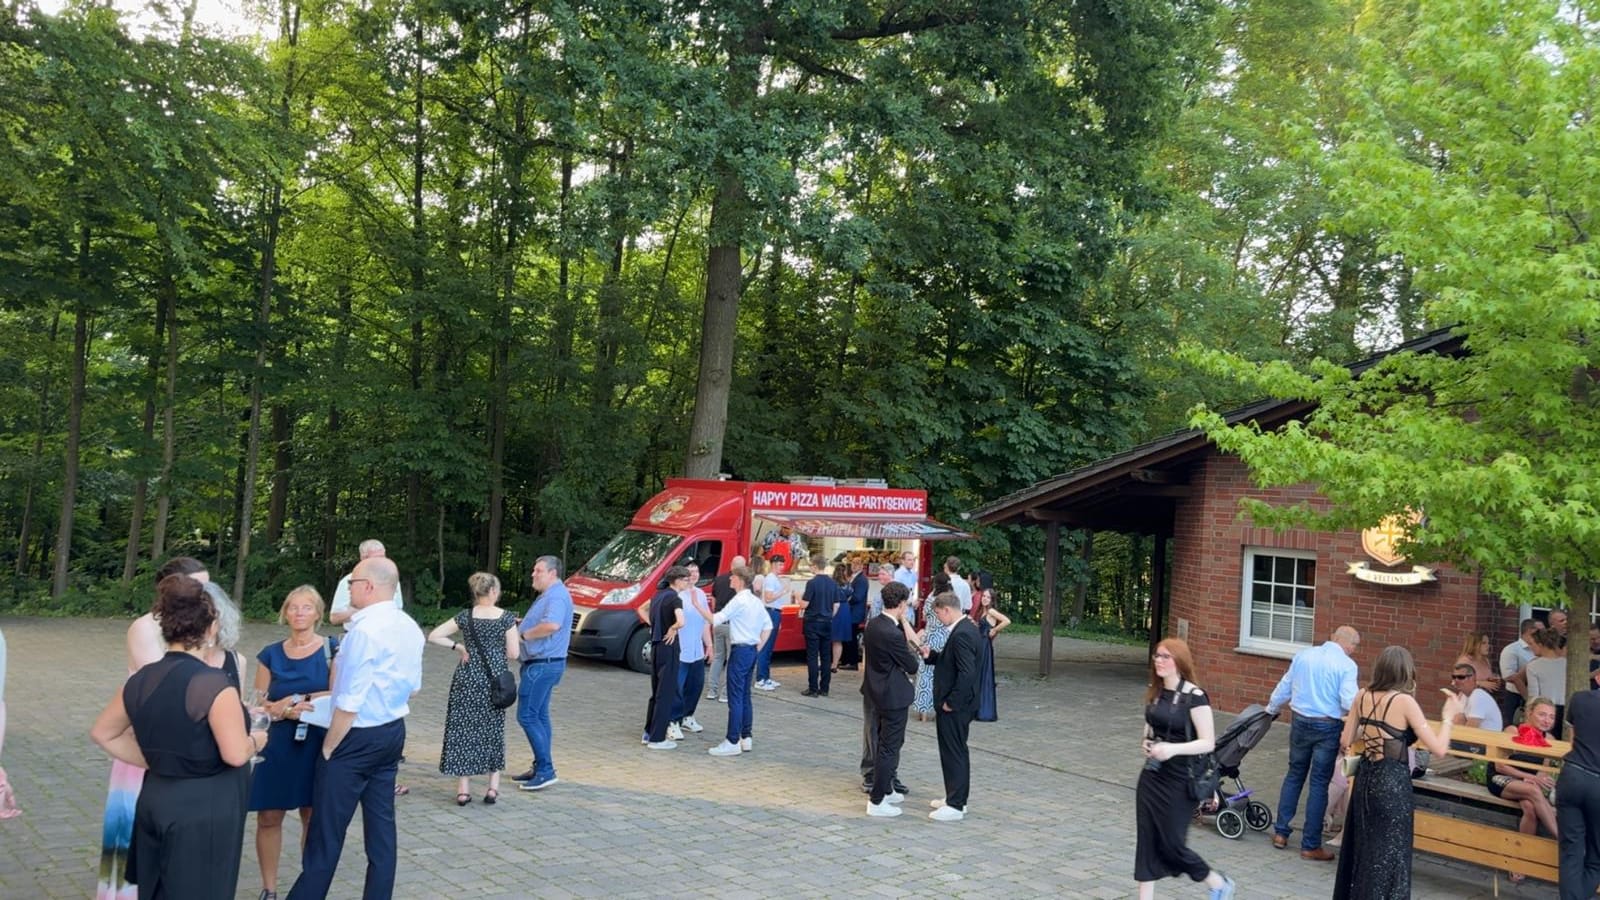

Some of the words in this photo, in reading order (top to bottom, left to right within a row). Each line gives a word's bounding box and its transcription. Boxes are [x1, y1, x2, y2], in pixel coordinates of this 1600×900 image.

[752, 490, 788, 506] HAPYY
[790, 492, 819, 507] PIZZA
[821, 493, 924, 511] WAGEN-PARTYSERVICE
